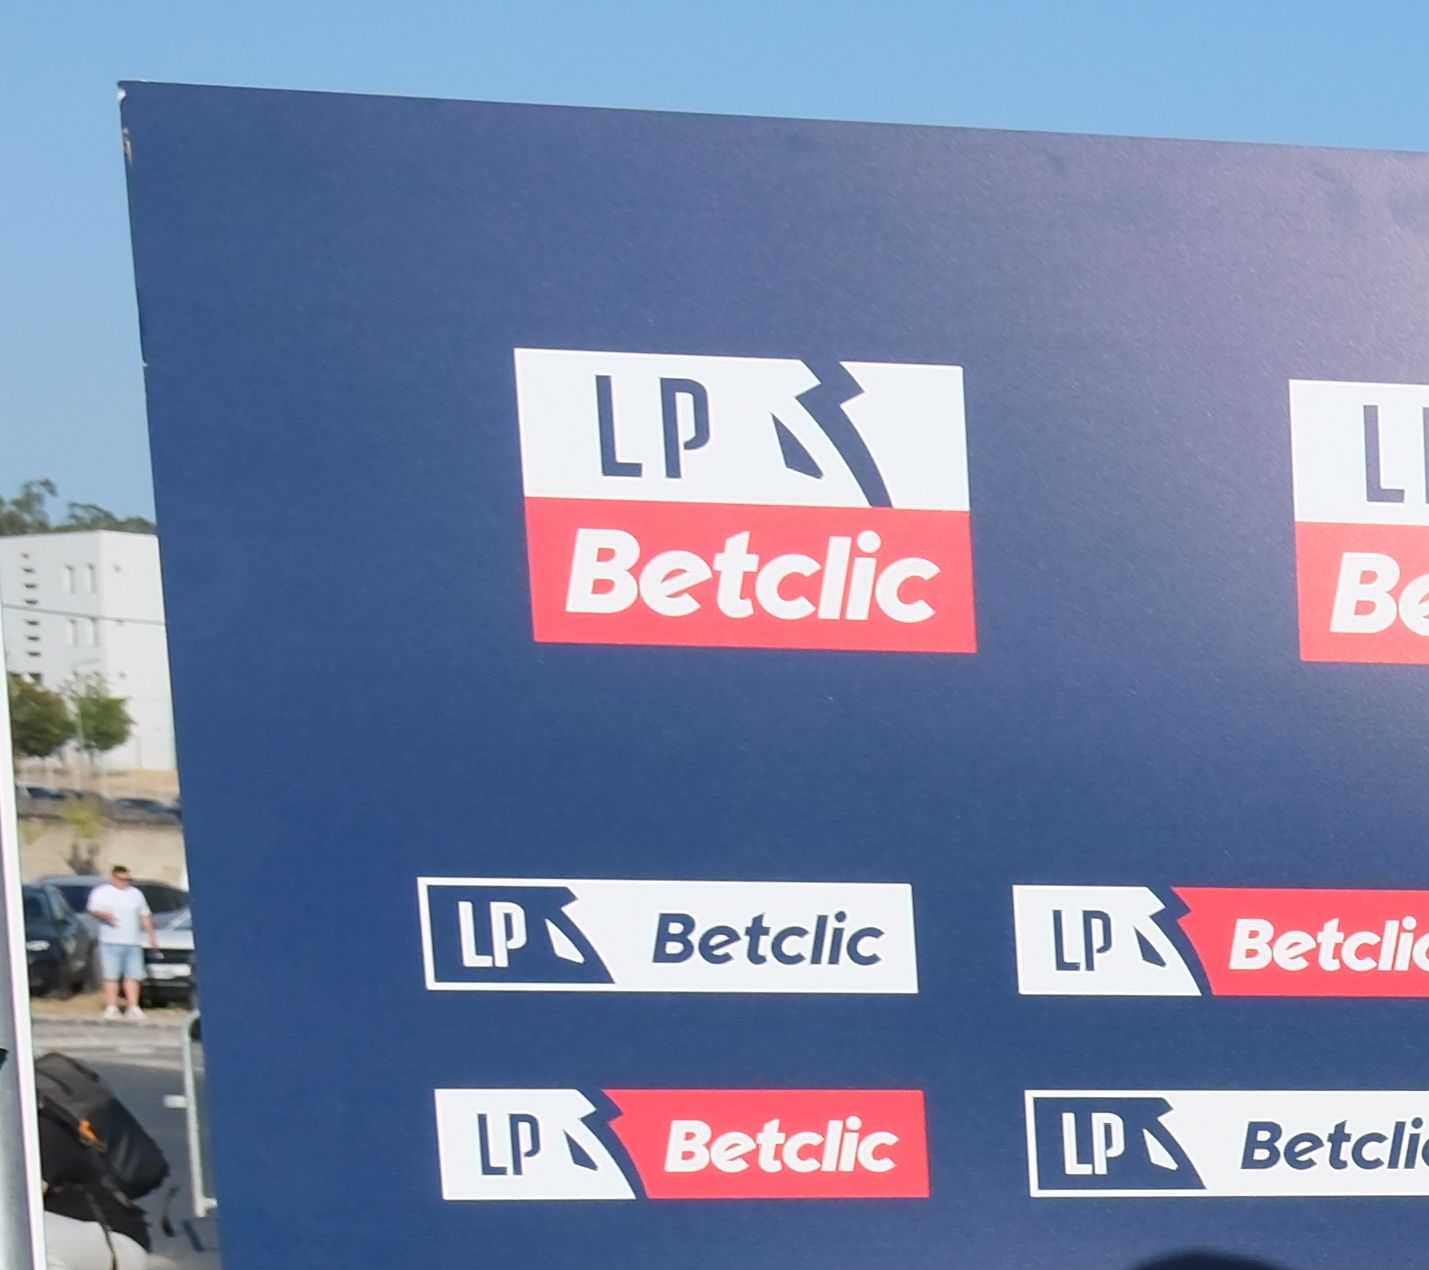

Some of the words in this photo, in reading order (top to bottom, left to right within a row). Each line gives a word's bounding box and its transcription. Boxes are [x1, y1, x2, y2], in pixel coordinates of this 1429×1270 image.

[595, 374, 711, 479] LP
[566, 527, 941, 623] Betclic
[457, 901, 527, 968] LP
[651, 910, 885, 966] Betclic
[1052, 908, 1112, 972] LP
[477, 1112, 541, 1176] LP
[664, 1115, 899, 1174] Betclic
[1060, 1111, 1125, 1175] LP
